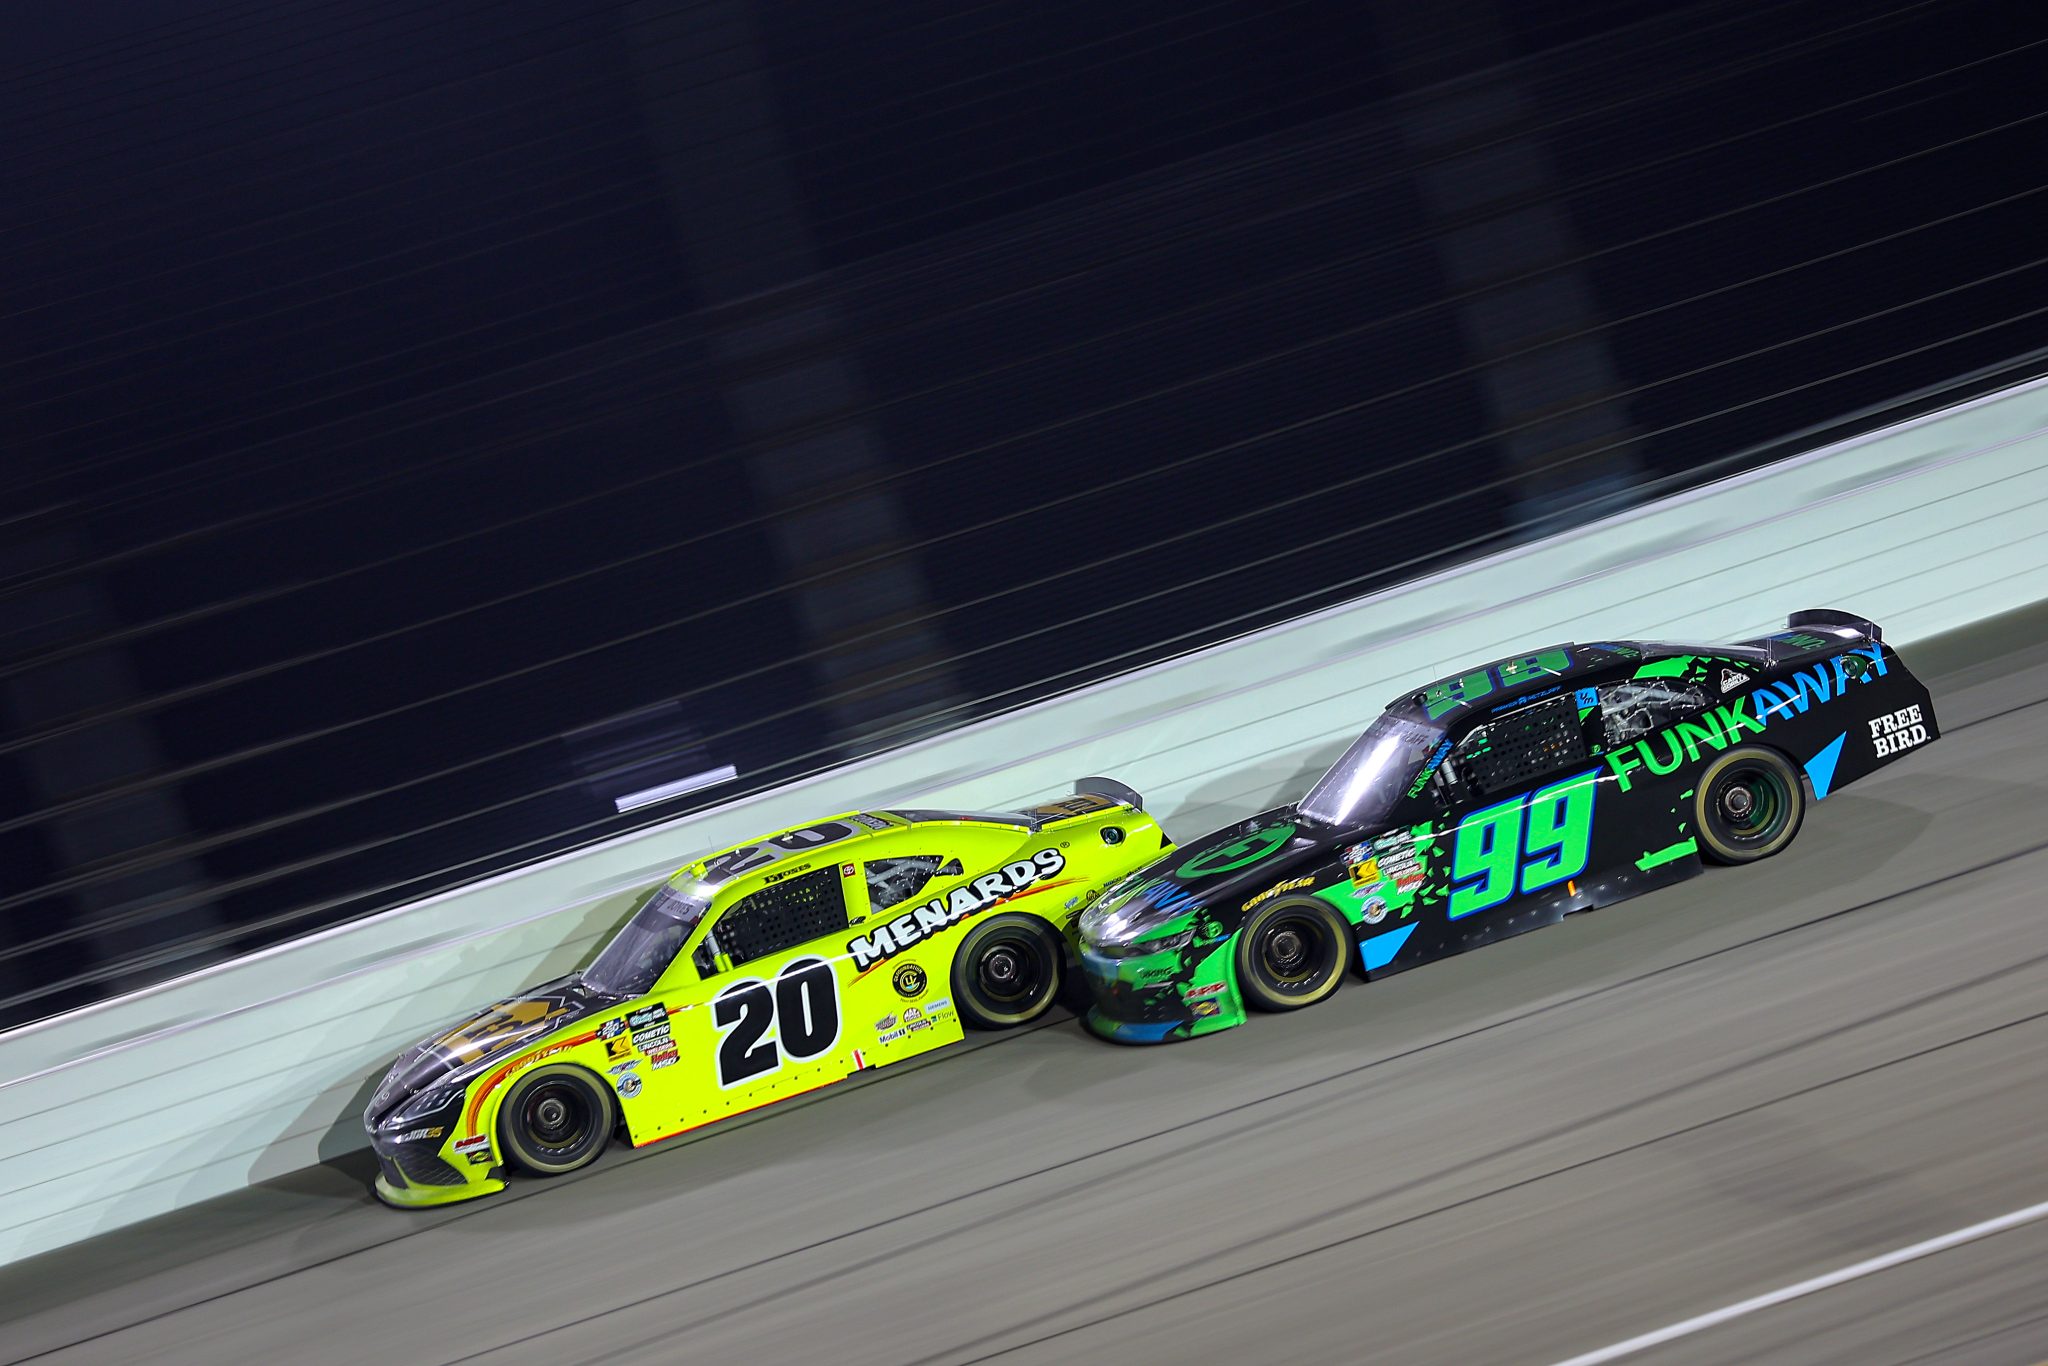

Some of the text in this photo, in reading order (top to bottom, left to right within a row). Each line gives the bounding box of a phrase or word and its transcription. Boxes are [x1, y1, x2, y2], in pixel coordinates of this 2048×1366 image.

[1868, 704, 1923, 739] FREE
[1873, 724, 1927, 758] BIRD
[702, 822, 853, 886] 20
[1448, 767, 1602, 920] 99
[847, 845, 1067, 972] MENARDS
[632, 1024, 670, 1044] COMETIC
[711, 955, 841, 1090] 20
[879, 1031, 899, 1043] Mobil
